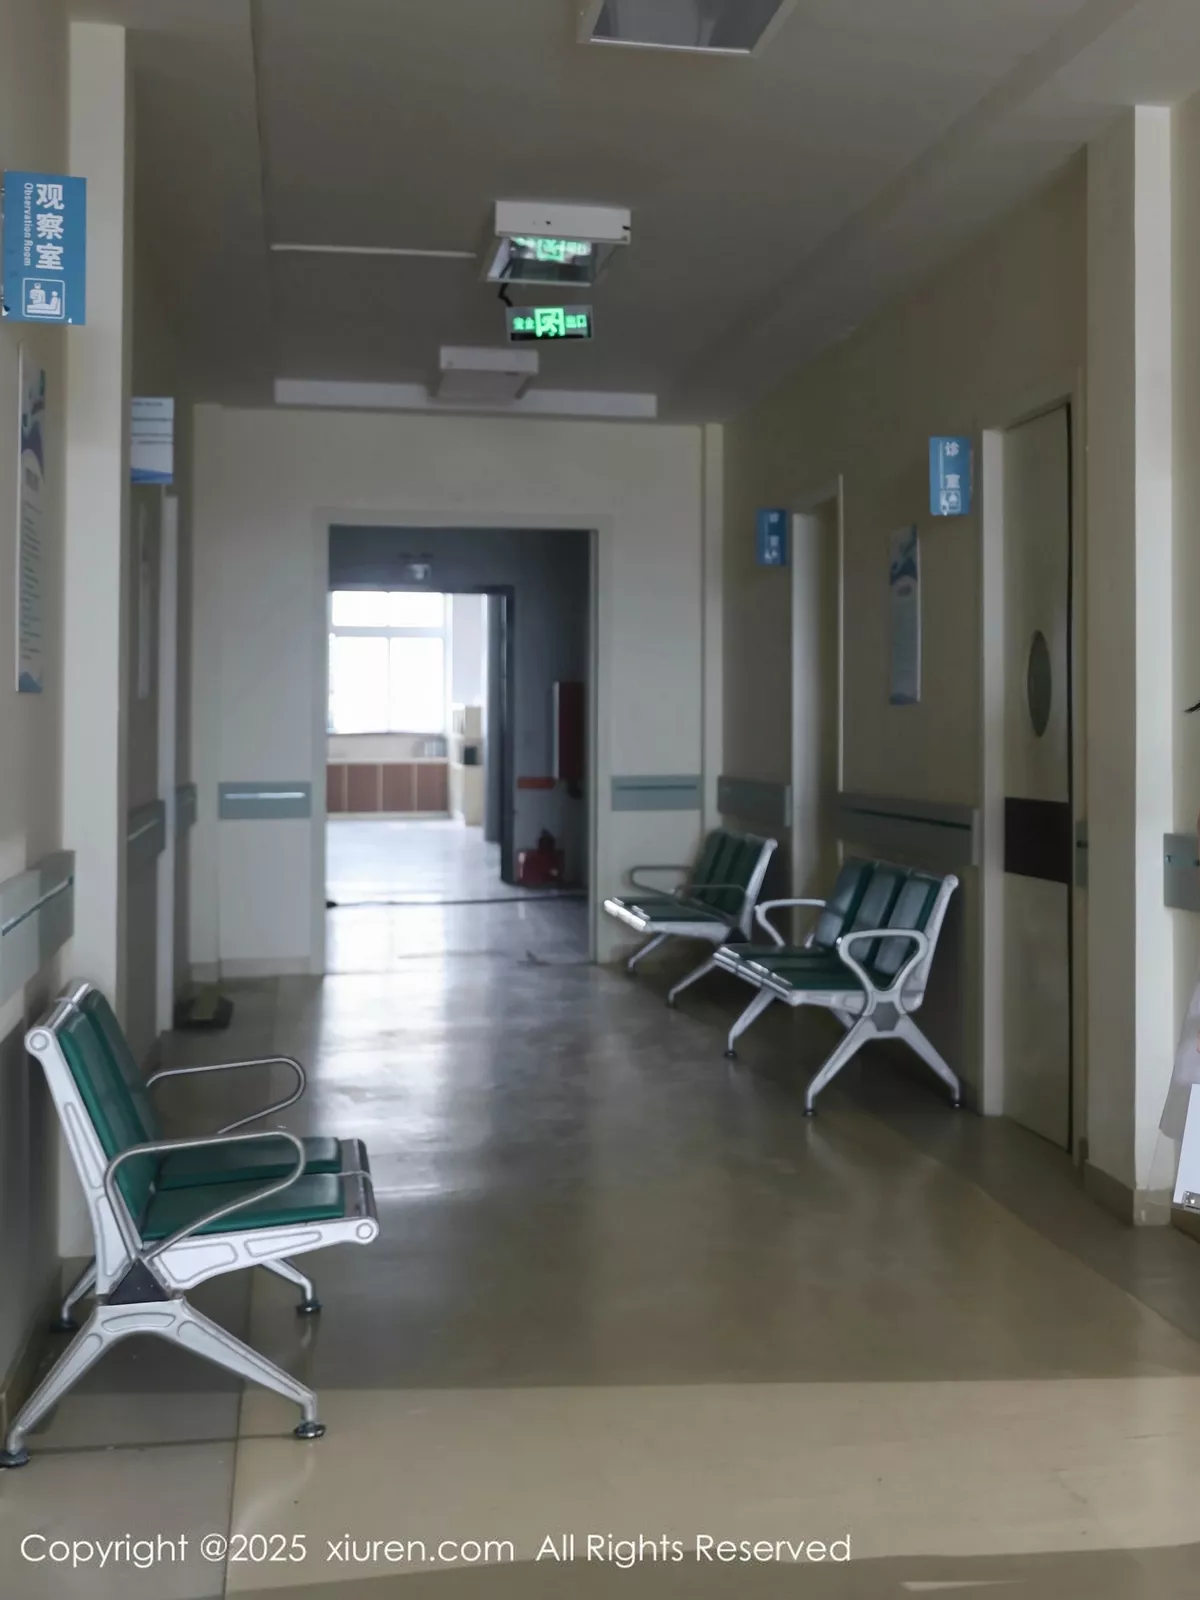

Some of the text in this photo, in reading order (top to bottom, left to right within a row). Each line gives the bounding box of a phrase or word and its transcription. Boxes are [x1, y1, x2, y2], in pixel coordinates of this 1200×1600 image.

[24, 183, 33, 266] Observation Room
[35, 184, 65, 271] 观察室
